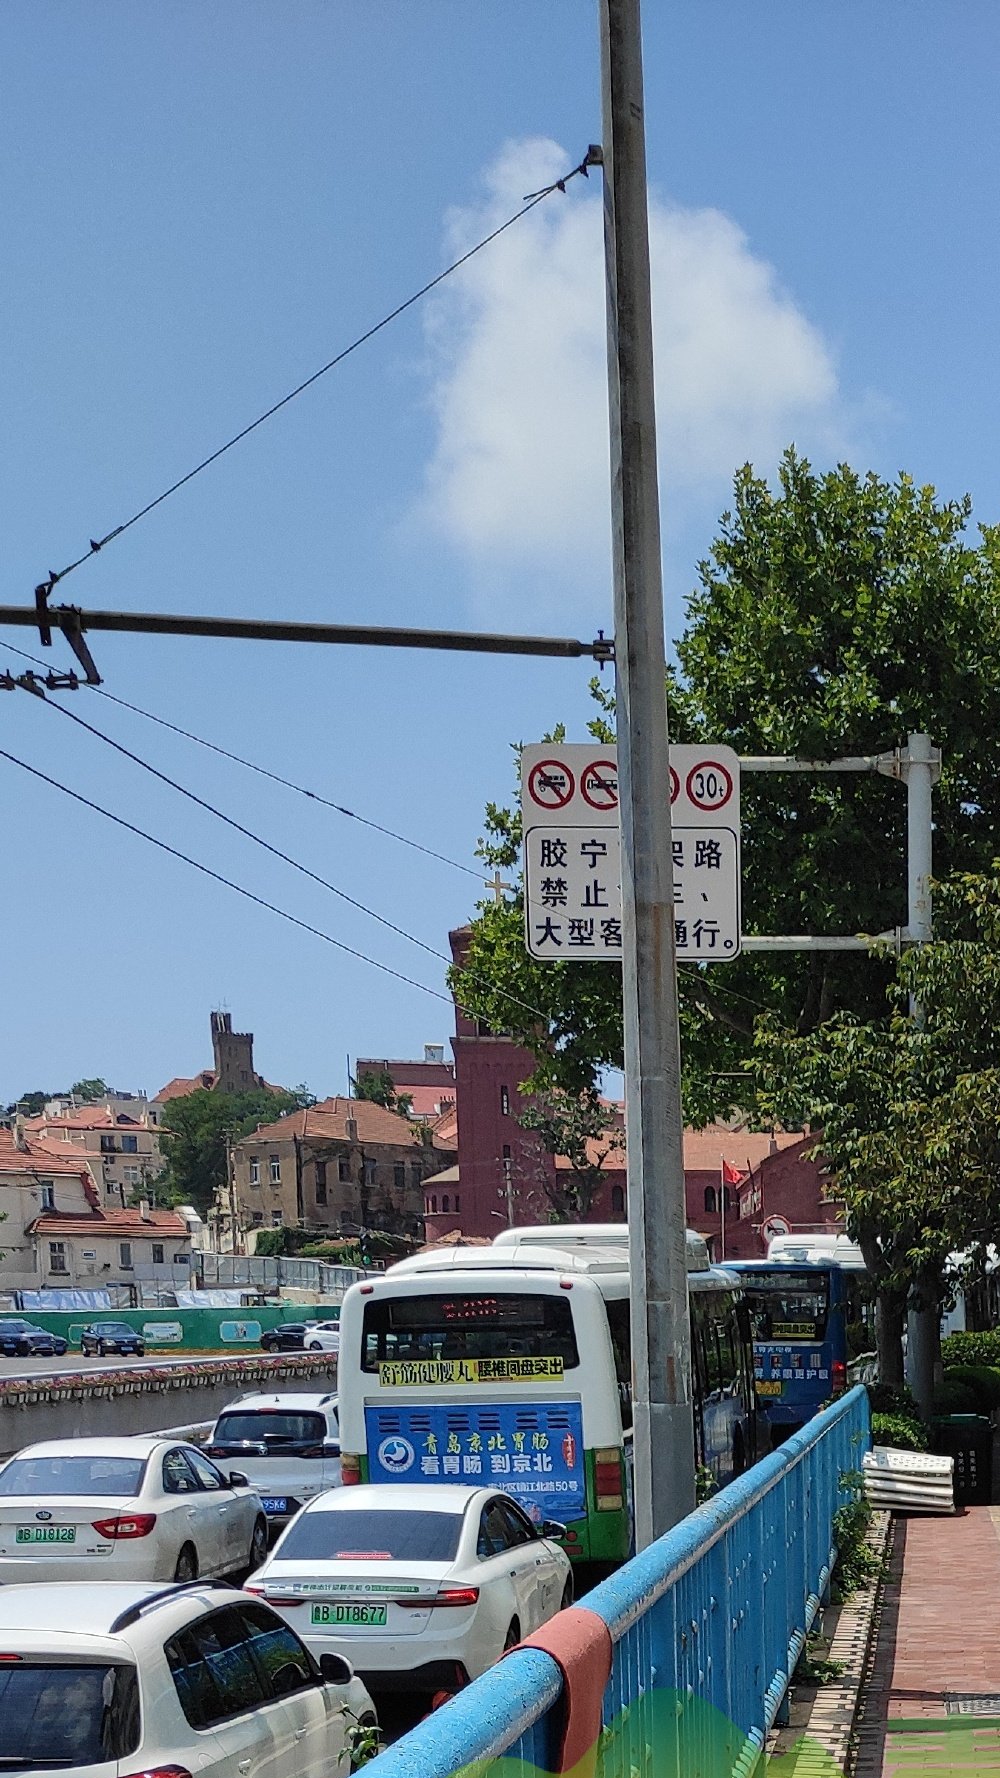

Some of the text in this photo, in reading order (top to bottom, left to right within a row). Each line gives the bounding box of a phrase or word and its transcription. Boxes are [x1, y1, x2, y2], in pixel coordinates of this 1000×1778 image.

[695, 773, 723, 799] 30t
[540, 839, 722, 869] 胶宁路
[478, 1359, 563, 1377] 腰椎间盘突出
[421, 1432, 549, 1454] 青岛京北胃肠
[421, 1454, 553, 1475] 看胃肠 到京北
